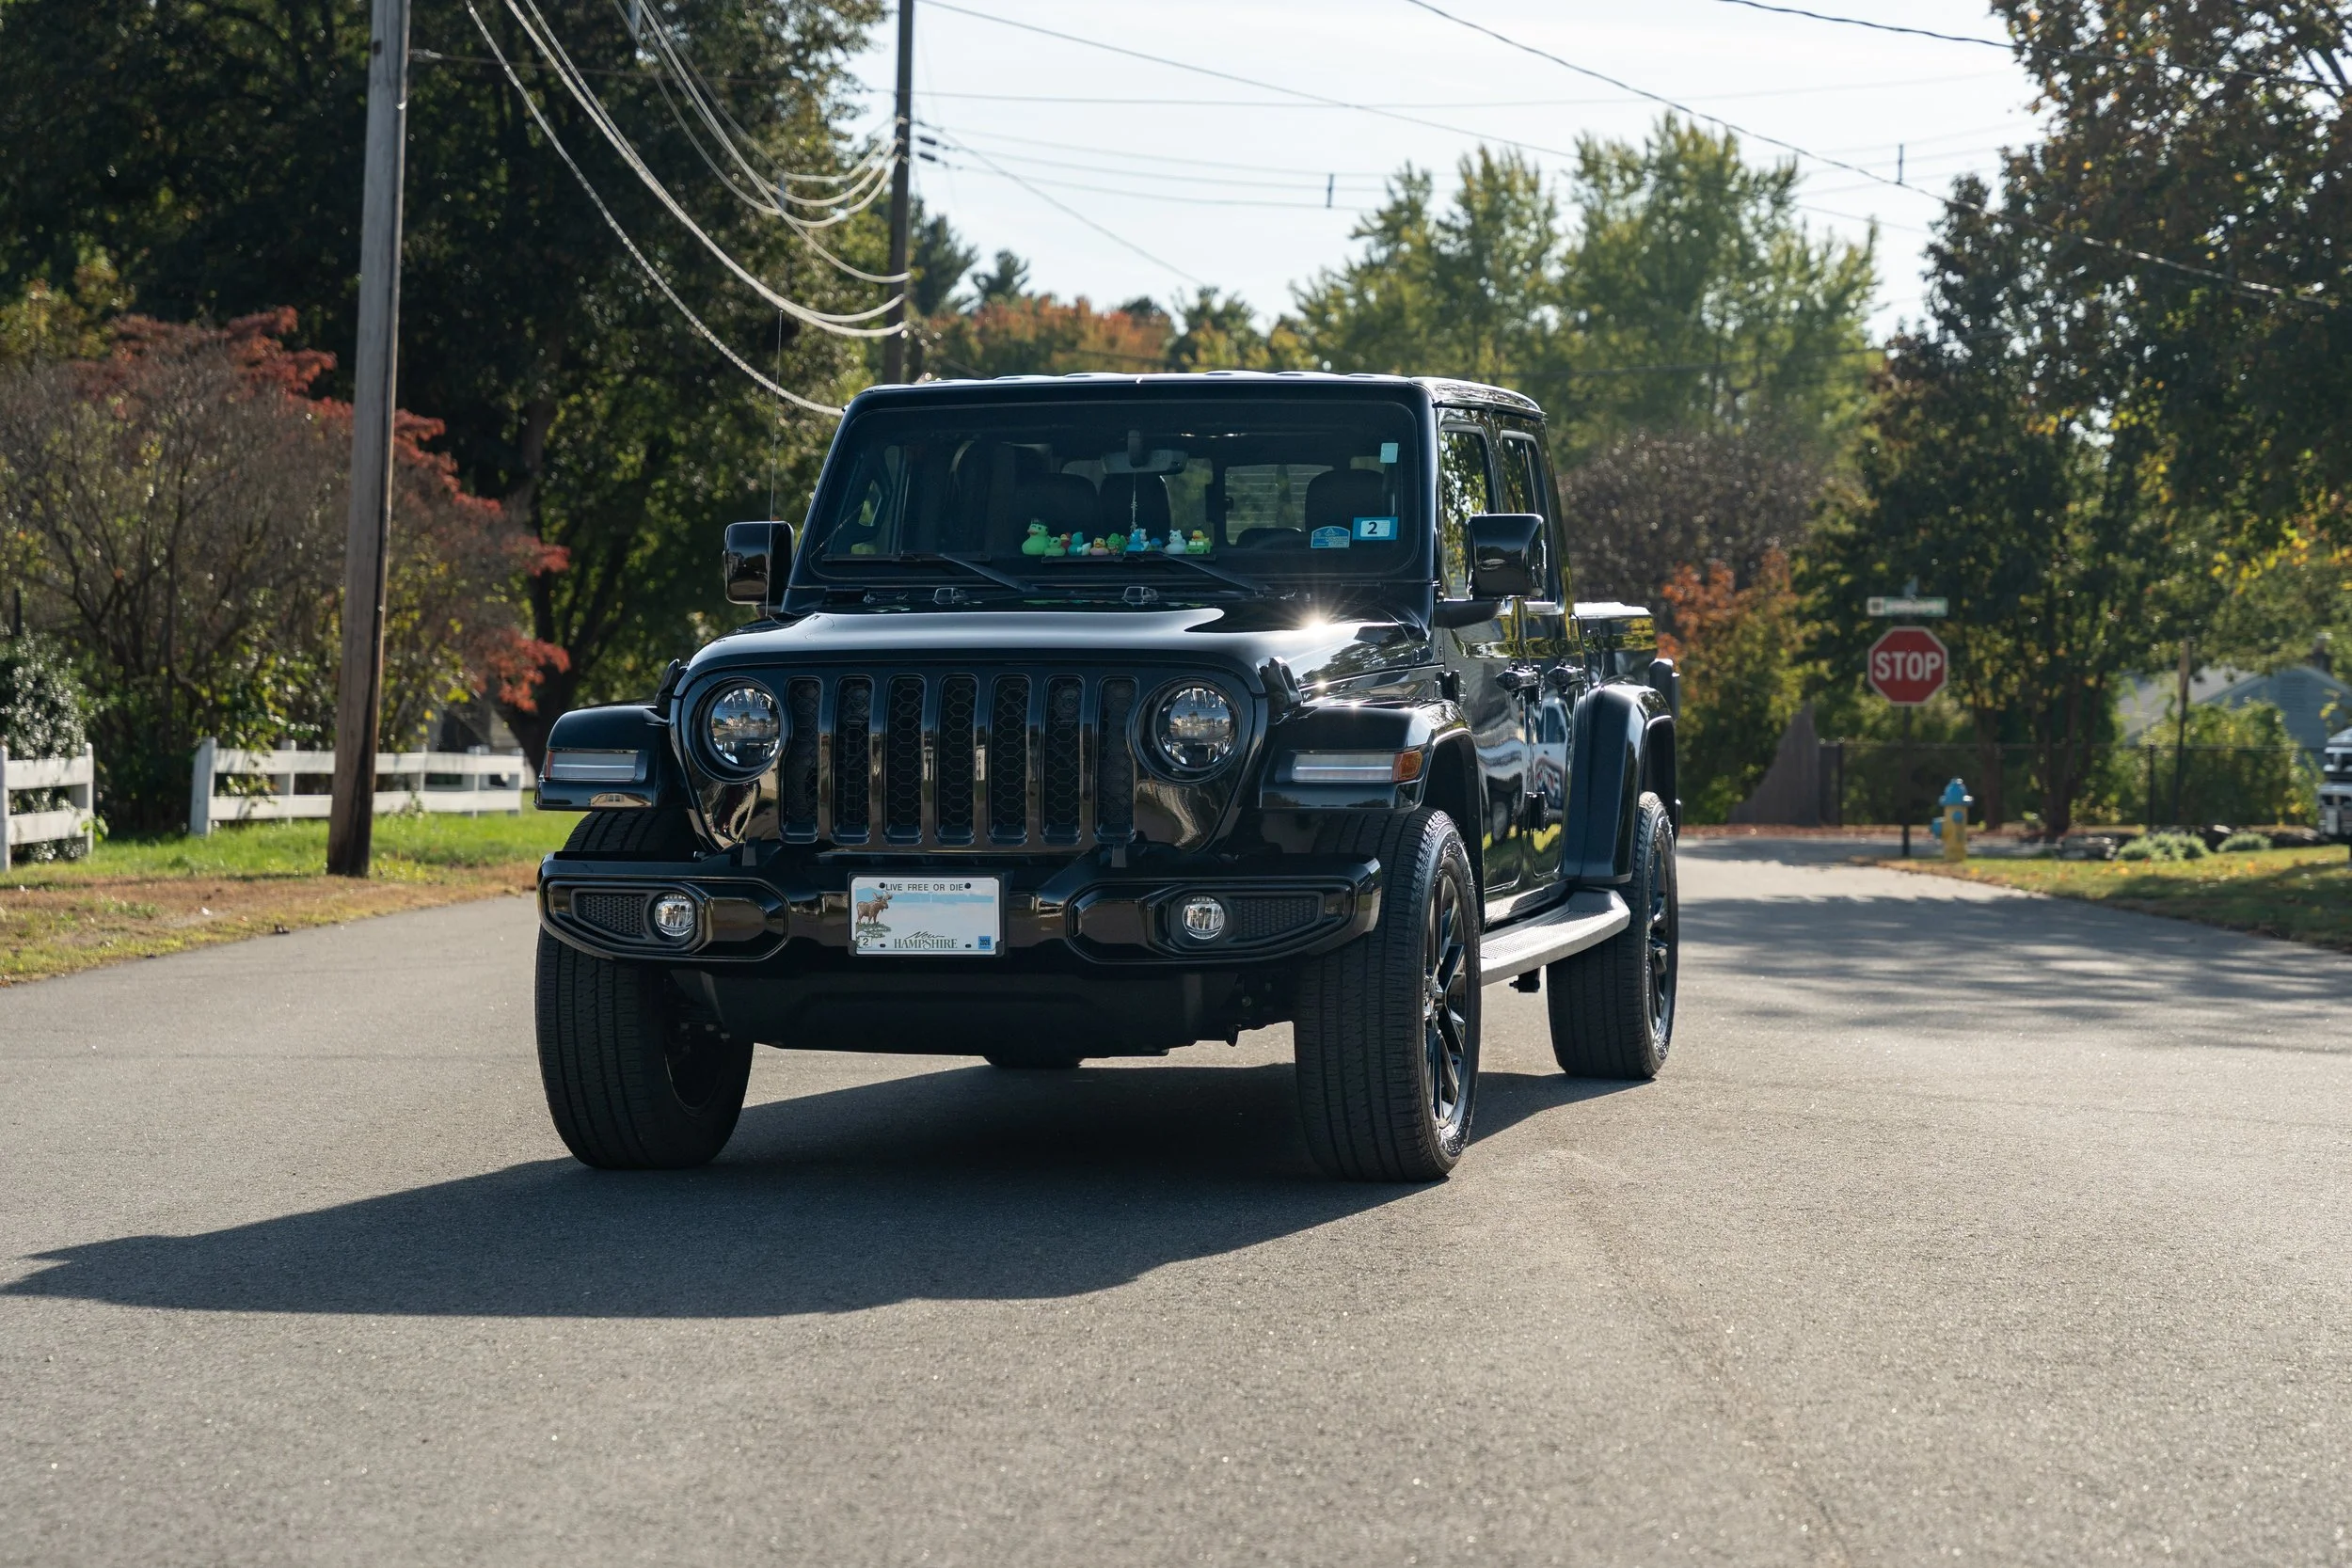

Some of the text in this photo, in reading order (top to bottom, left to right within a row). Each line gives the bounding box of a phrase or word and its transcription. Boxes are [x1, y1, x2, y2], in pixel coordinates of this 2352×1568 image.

[1368, 522, 1377, 534] 2
[1874, 651, 1942, 681] STOP
[907, 883, 929, 892] FREE
[932, 883, 946, 892] OR
[949, 883, 963, 892] DIE
[905, 930, 946, 940] New
[863, 937, 869, 946] 2
[894, 938, 958, 950] HAMPSHIRE
